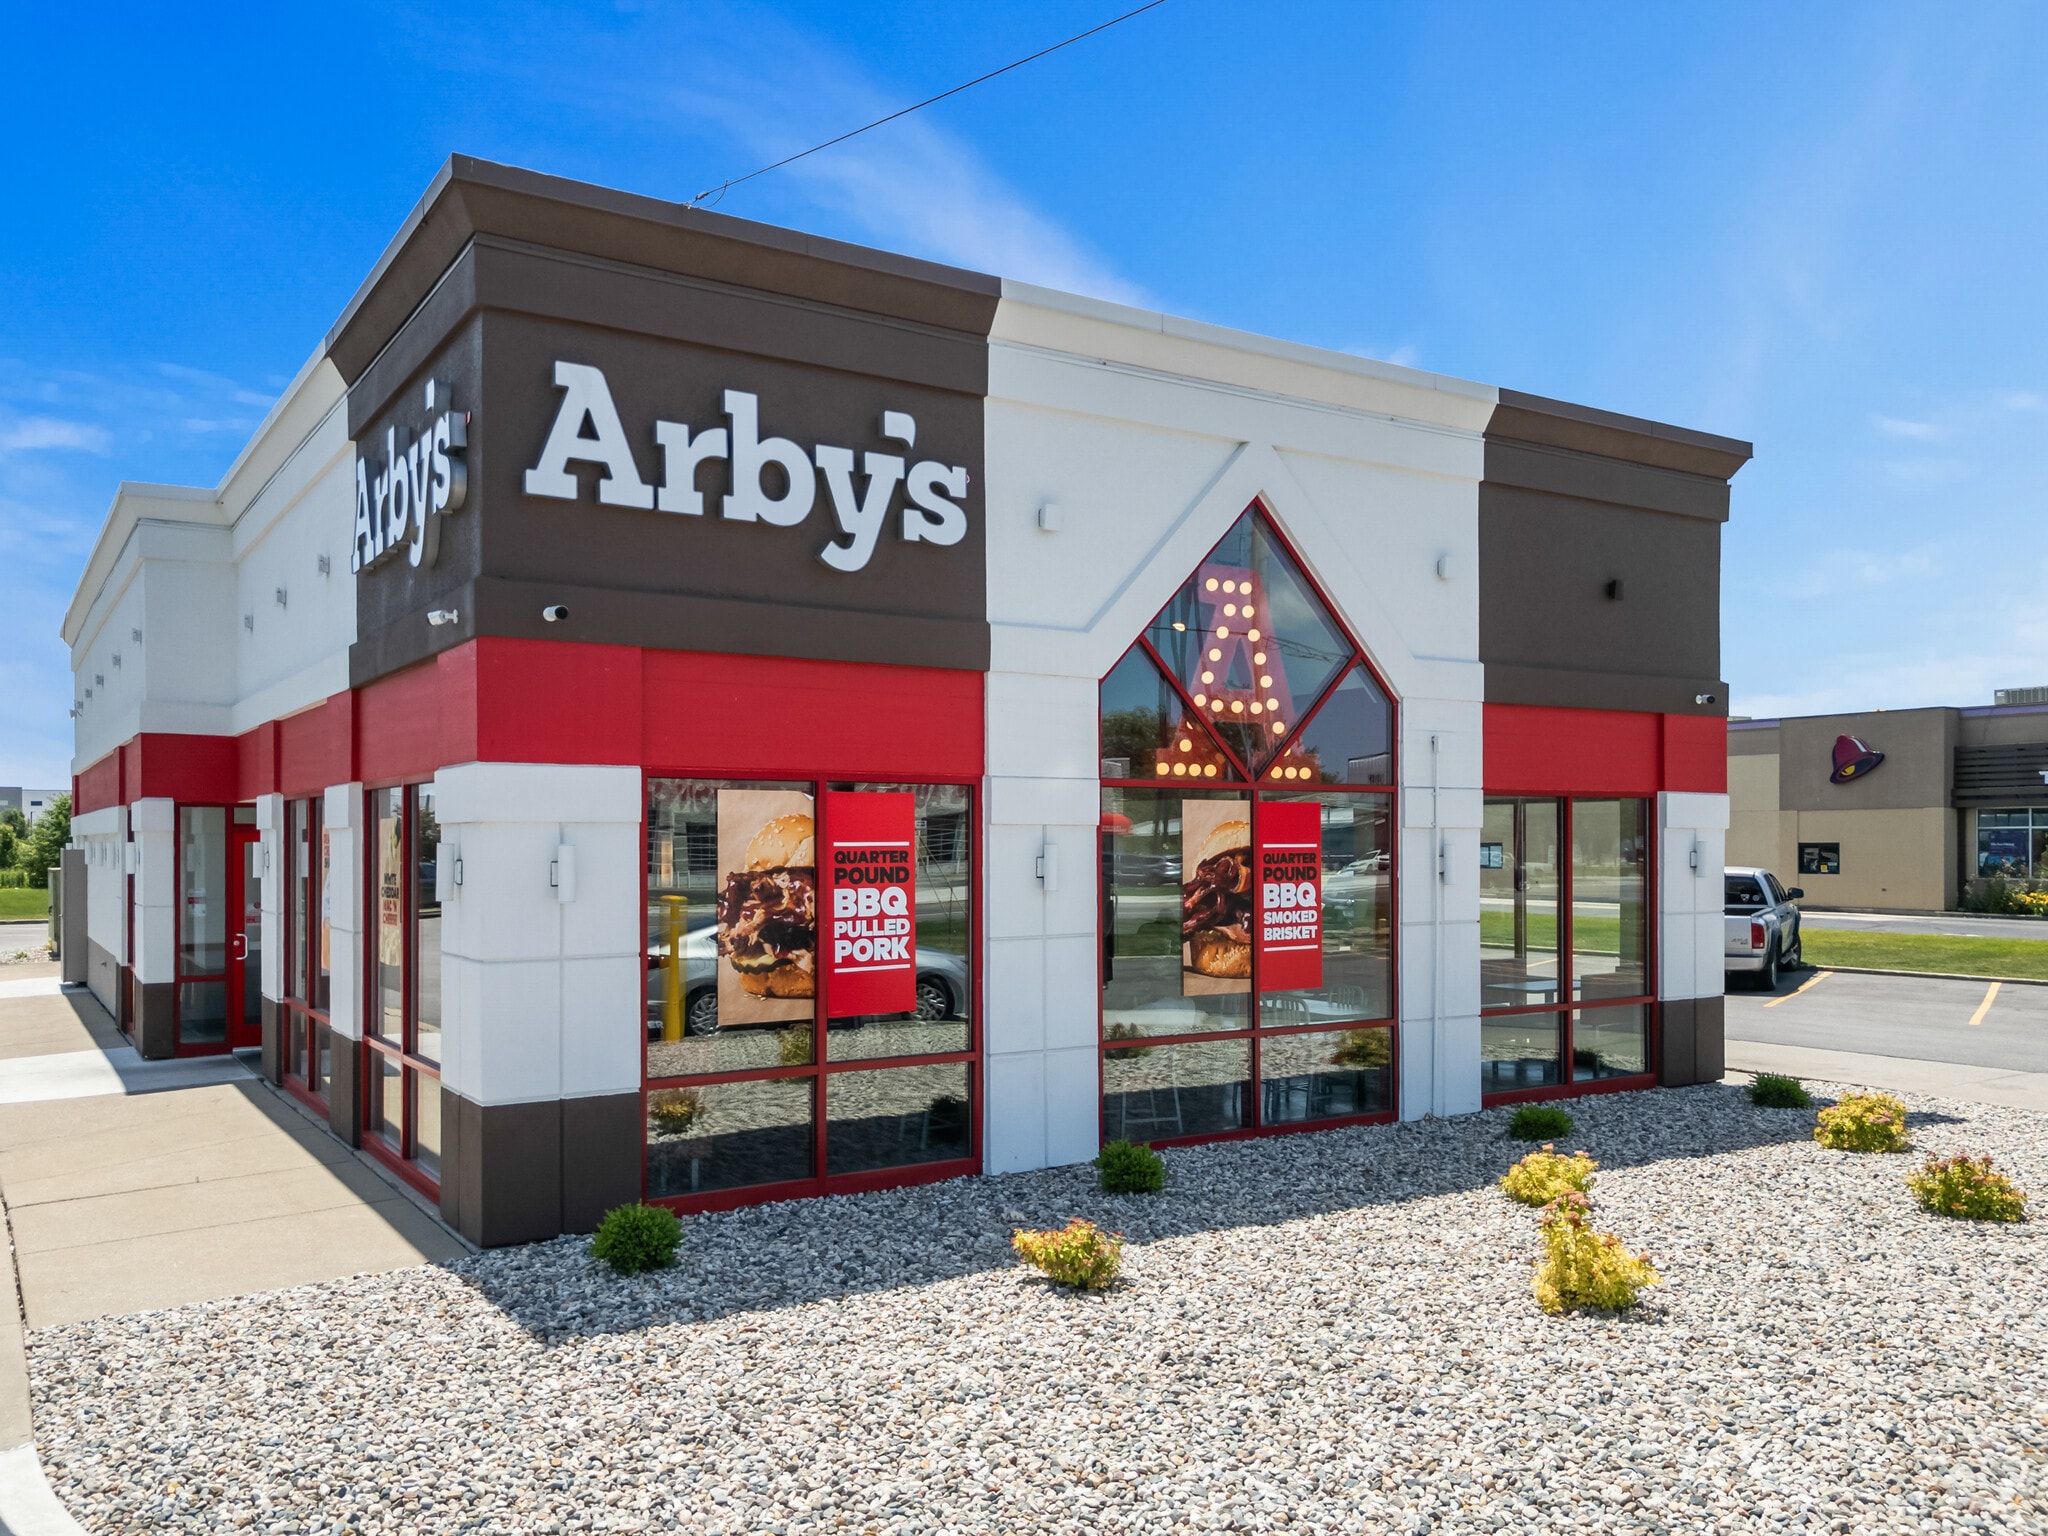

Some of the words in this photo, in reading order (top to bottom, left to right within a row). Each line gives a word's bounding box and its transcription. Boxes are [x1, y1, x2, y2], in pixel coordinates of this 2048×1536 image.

[523, 360, 968, 572] Arby's
[351, 377, 462, 575] Arby's
[833, 850, 909, 864] QUARTER
[1263, 852, 1317, 865] QUARTER
[833, 866, 910, 885] POUND
[1263, 866, 1317, 881] POUND
[833, 886, 909, 918] BBQ
[1263, 882, 1317, 909] BBQ
[1263, 909, 1317, 925] SMOKED
[833, 918, 911, 938] PULLED
[1263, 925, 1318, 941] BRISKET
[834, 936, 911, 963] PORK
